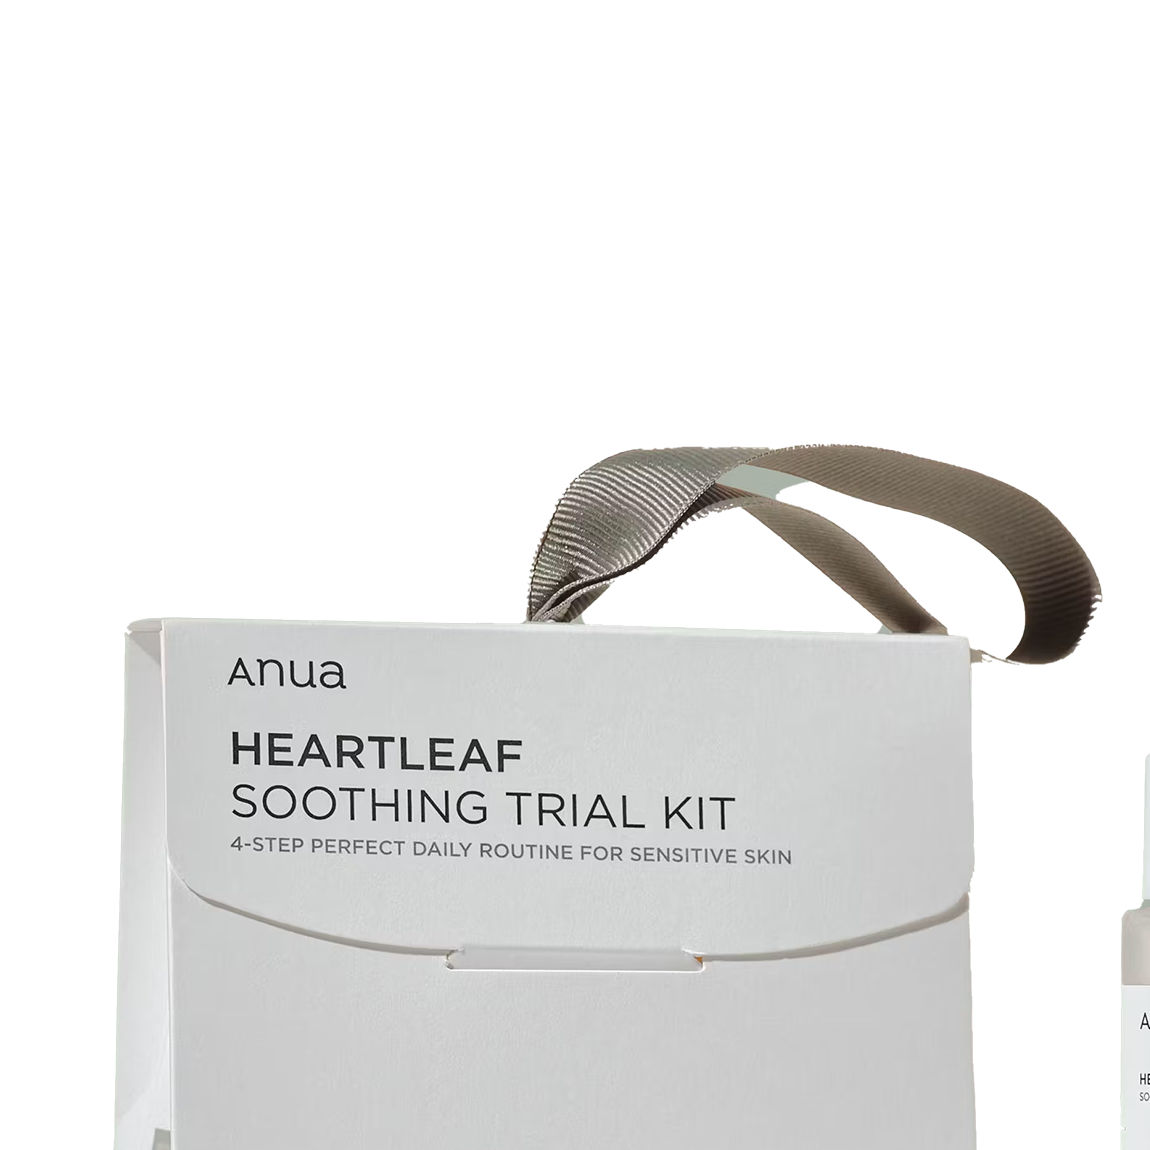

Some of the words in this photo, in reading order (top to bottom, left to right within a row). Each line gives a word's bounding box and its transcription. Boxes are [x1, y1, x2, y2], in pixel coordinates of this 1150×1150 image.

[228, 658, 346, 689] Anua
[232, 732, 522, 772] HEARTLEAF
[232, 784, 487, 824] SOOTHING
[506, 792, 645, 828] TRIAL
[665, 796, 735, 830] KIT
[231, 836, 303, 852] 4-STEP
[312, 839, 405, 855] PERFECT
[413, 842, 472, 857] DAILY
[480, 843, 572, 859] ROUTINE
[581, 846, 622, 861] FOR
[631, 847, 737, 863] SENSITIVE
[745, 850, 791, 864] SKIN
